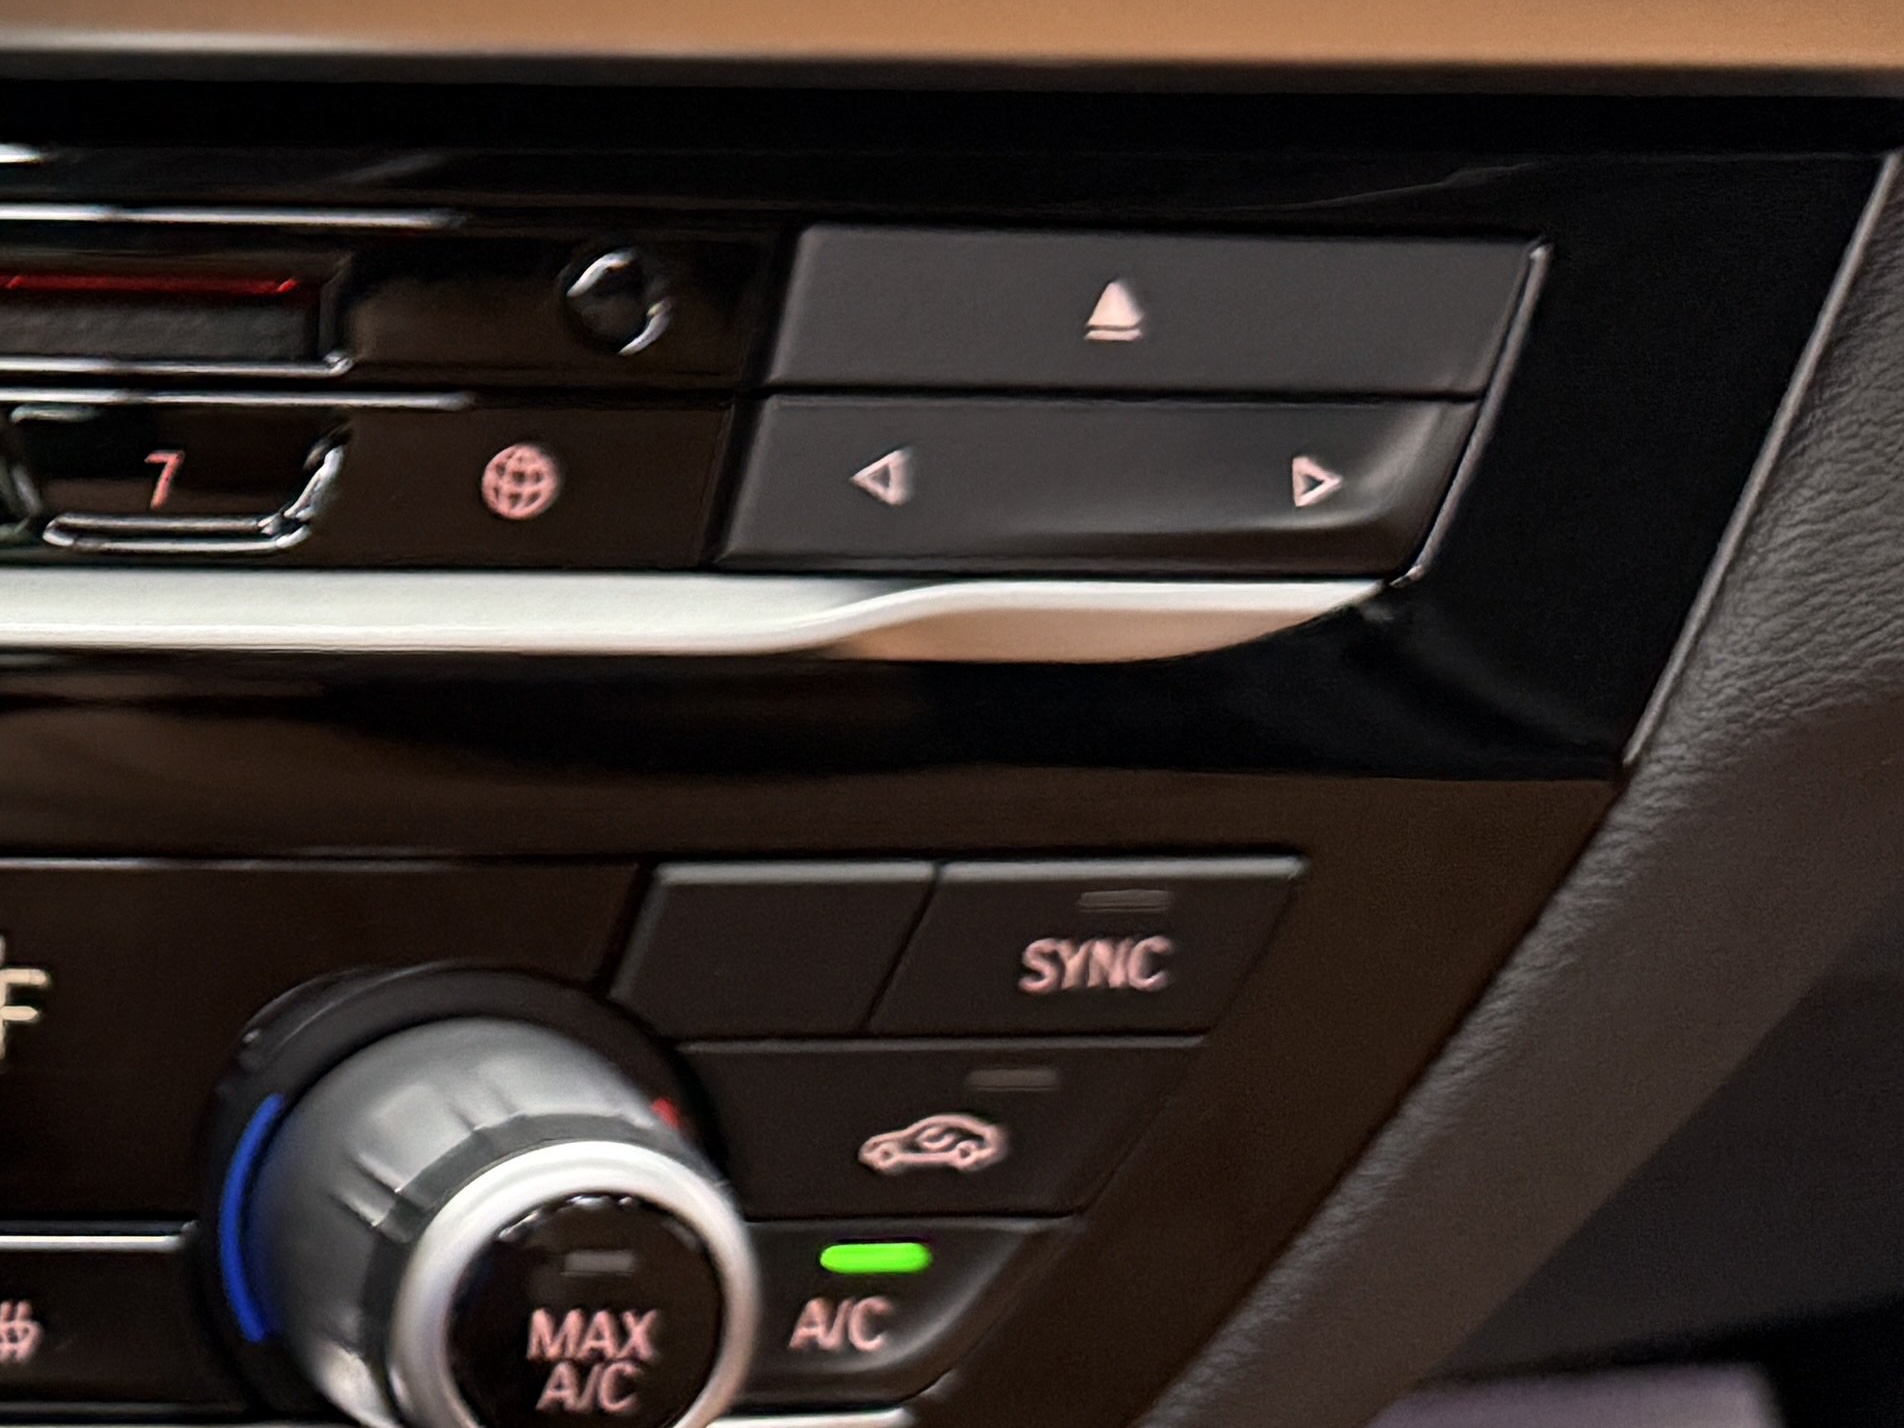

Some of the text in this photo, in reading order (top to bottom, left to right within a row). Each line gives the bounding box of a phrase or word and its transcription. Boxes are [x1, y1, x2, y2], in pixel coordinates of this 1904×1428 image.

[145, 451, 181, 508] 7
[1021, 936, 1171, 993] SYNC
[528, 1309, 658, 1364] MAX
[790, 1297, 892, 1354] A/C
[538, 1361, 639, 1413] A/C
